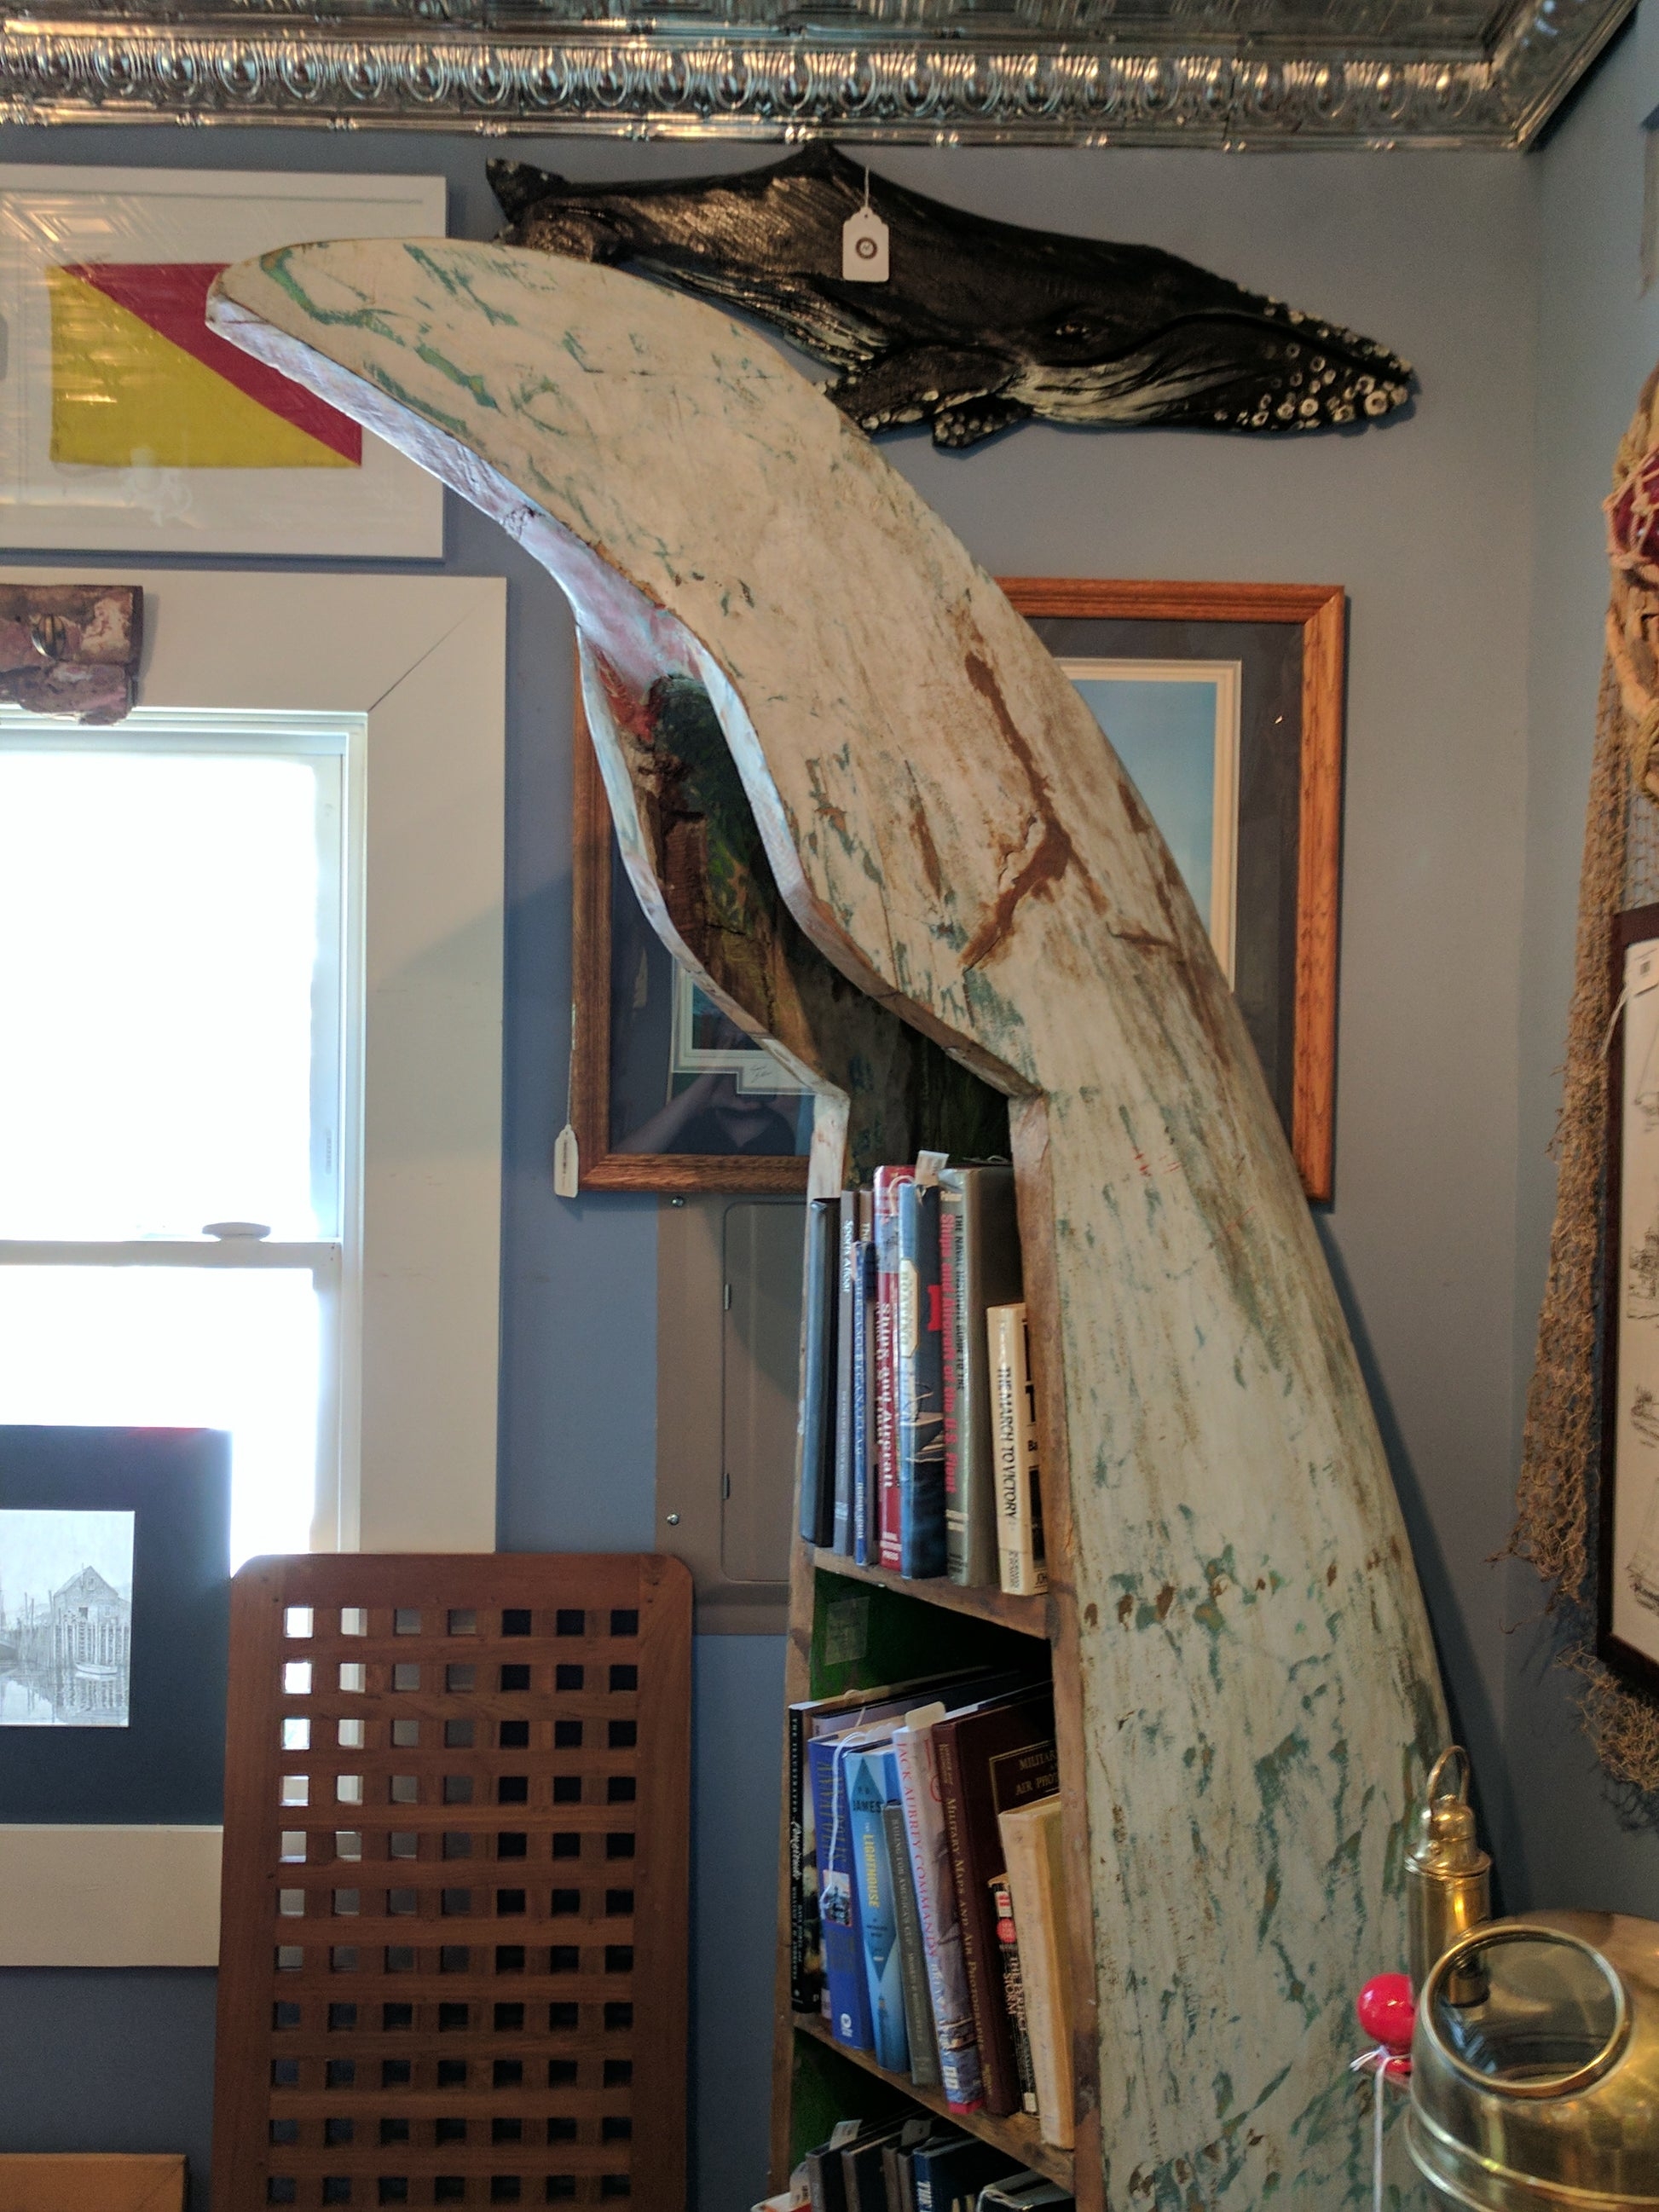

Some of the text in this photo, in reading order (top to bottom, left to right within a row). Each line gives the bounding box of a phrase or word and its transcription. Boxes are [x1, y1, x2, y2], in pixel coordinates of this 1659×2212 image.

[842, 1220, 853, 1293] Sports Afloat
[939, 1214, 955, 1257] Ships
[942, 1263, 955, 1292] and
[955, 1215, 965, 1391] THE NAVAL INSTITUTE GUIDE TO THE
[942, 1297, 956, 1360] Aircraft
[944, 1366, 956, 1383] of
[997, 1366, 1012, 1394] THE
[944, 1386, 957, 1412] the
[998, 1394, 1014, 1441] MARCH
[882, 1411, 893, 1487] Aircraft
[1001, 1446, 1014, 1463] TO
[944, 1453, 957, 1493] Fleet
[1003, 1464, 1017, 1520] VICTORY
[1019, 1749, 1056, 1770] MILITAR
[853, 1799, 882, 1813] JAMES
[892, 1818, 904, 1855] SAILING
[897, 1742, 938, 1958] JACK AUBREY COMMANDS
[863, 1834, 881, 1909] LIGHTHOUSE
[896, 1857, 906, 1875] FOR
[945, 1797, 985, 2052] MILITARY MAPS AND AIR PHOTOGRAPHS
[1009, 1956, 1020, 1978] THE
[1003, 1972, 1017, 2015] STORM
[1013, 1983, 1027, 2031] PERFECT
